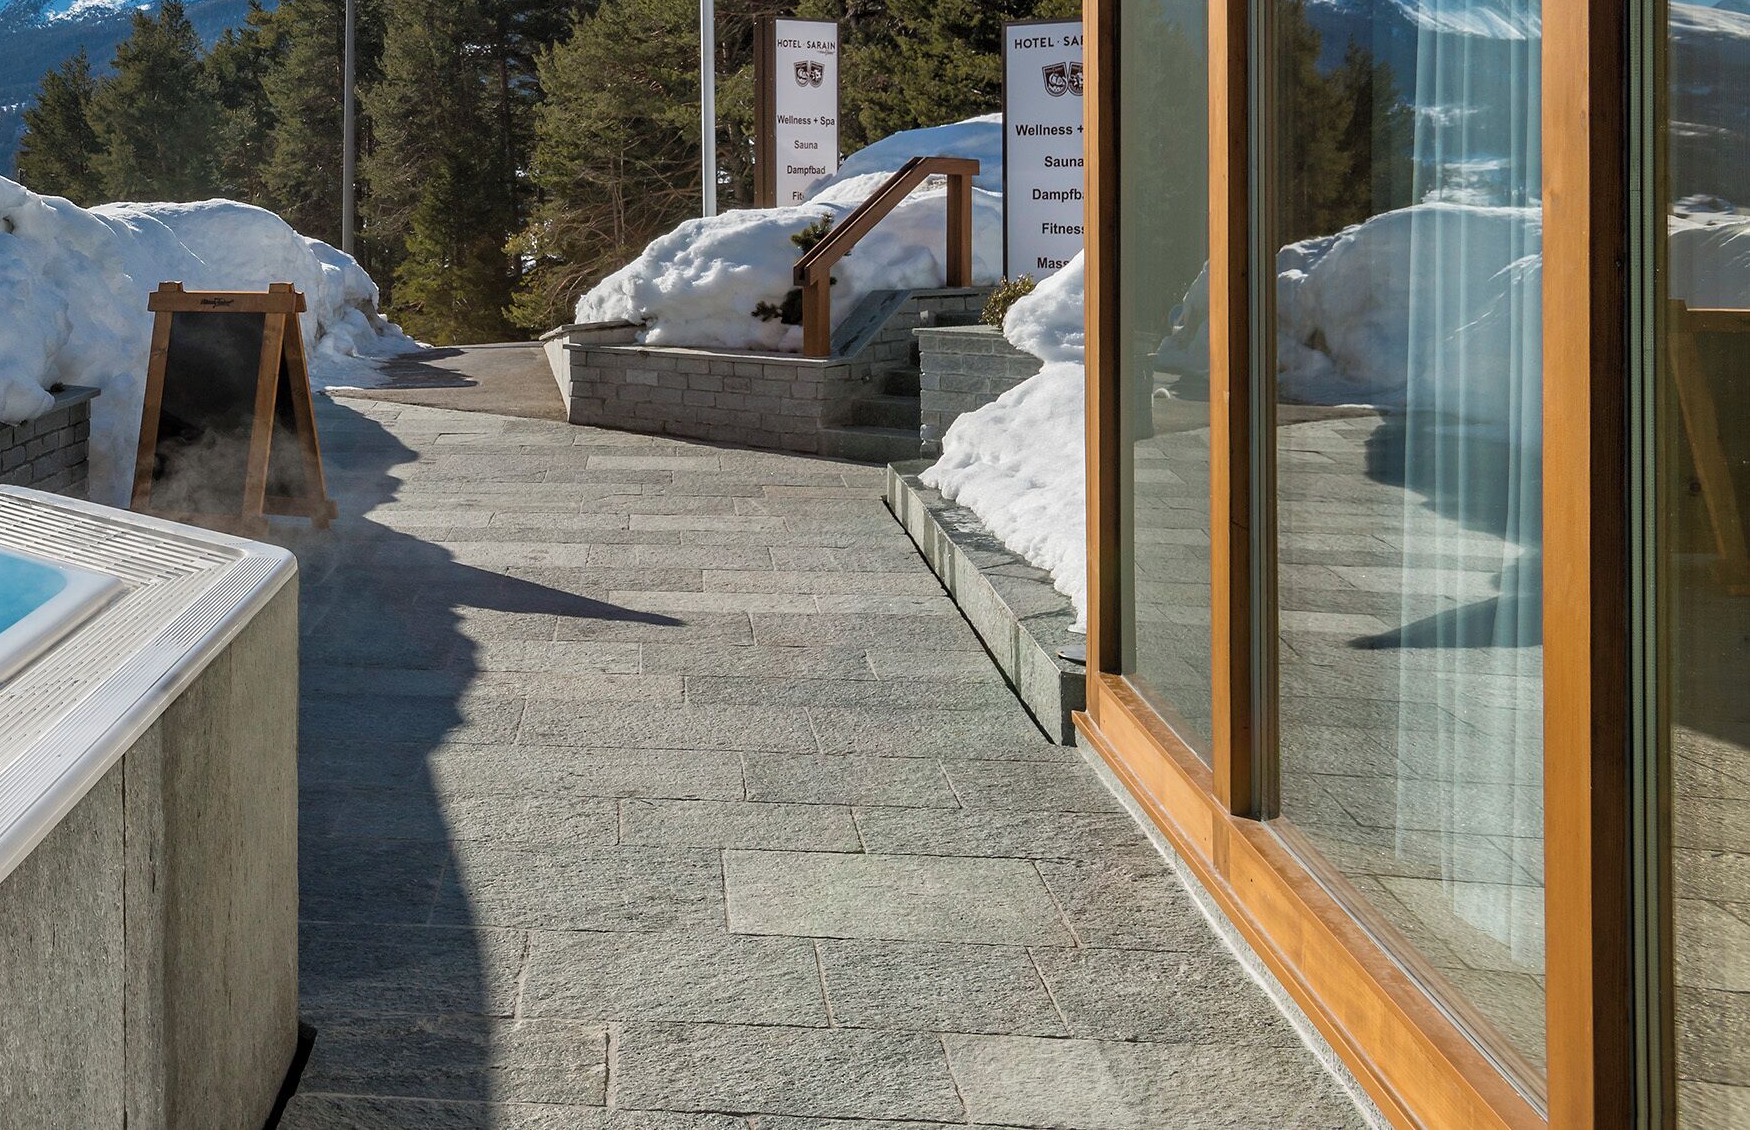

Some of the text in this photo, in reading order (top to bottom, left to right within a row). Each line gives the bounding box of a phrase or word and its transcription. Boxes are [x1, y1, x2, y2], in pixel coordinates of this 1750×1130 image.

[777, 39, 836, 50] HOTEL SARAIN
[1014, 35, 1084, 49] HOTEL SA
[777, 114, 812, 126] Wellness
[819, 116, 836, 127] Spa
[1015, 124, 1073, 137] Wellness
[794, 139, 819, 150] Sauna
[1044, 155, 1084, 168] Sauna
[786, 165, 826, 176] Dampfbad
[792, 191, 804, 201] Fit
[1032, 188, 1084, 203] Dampfb
